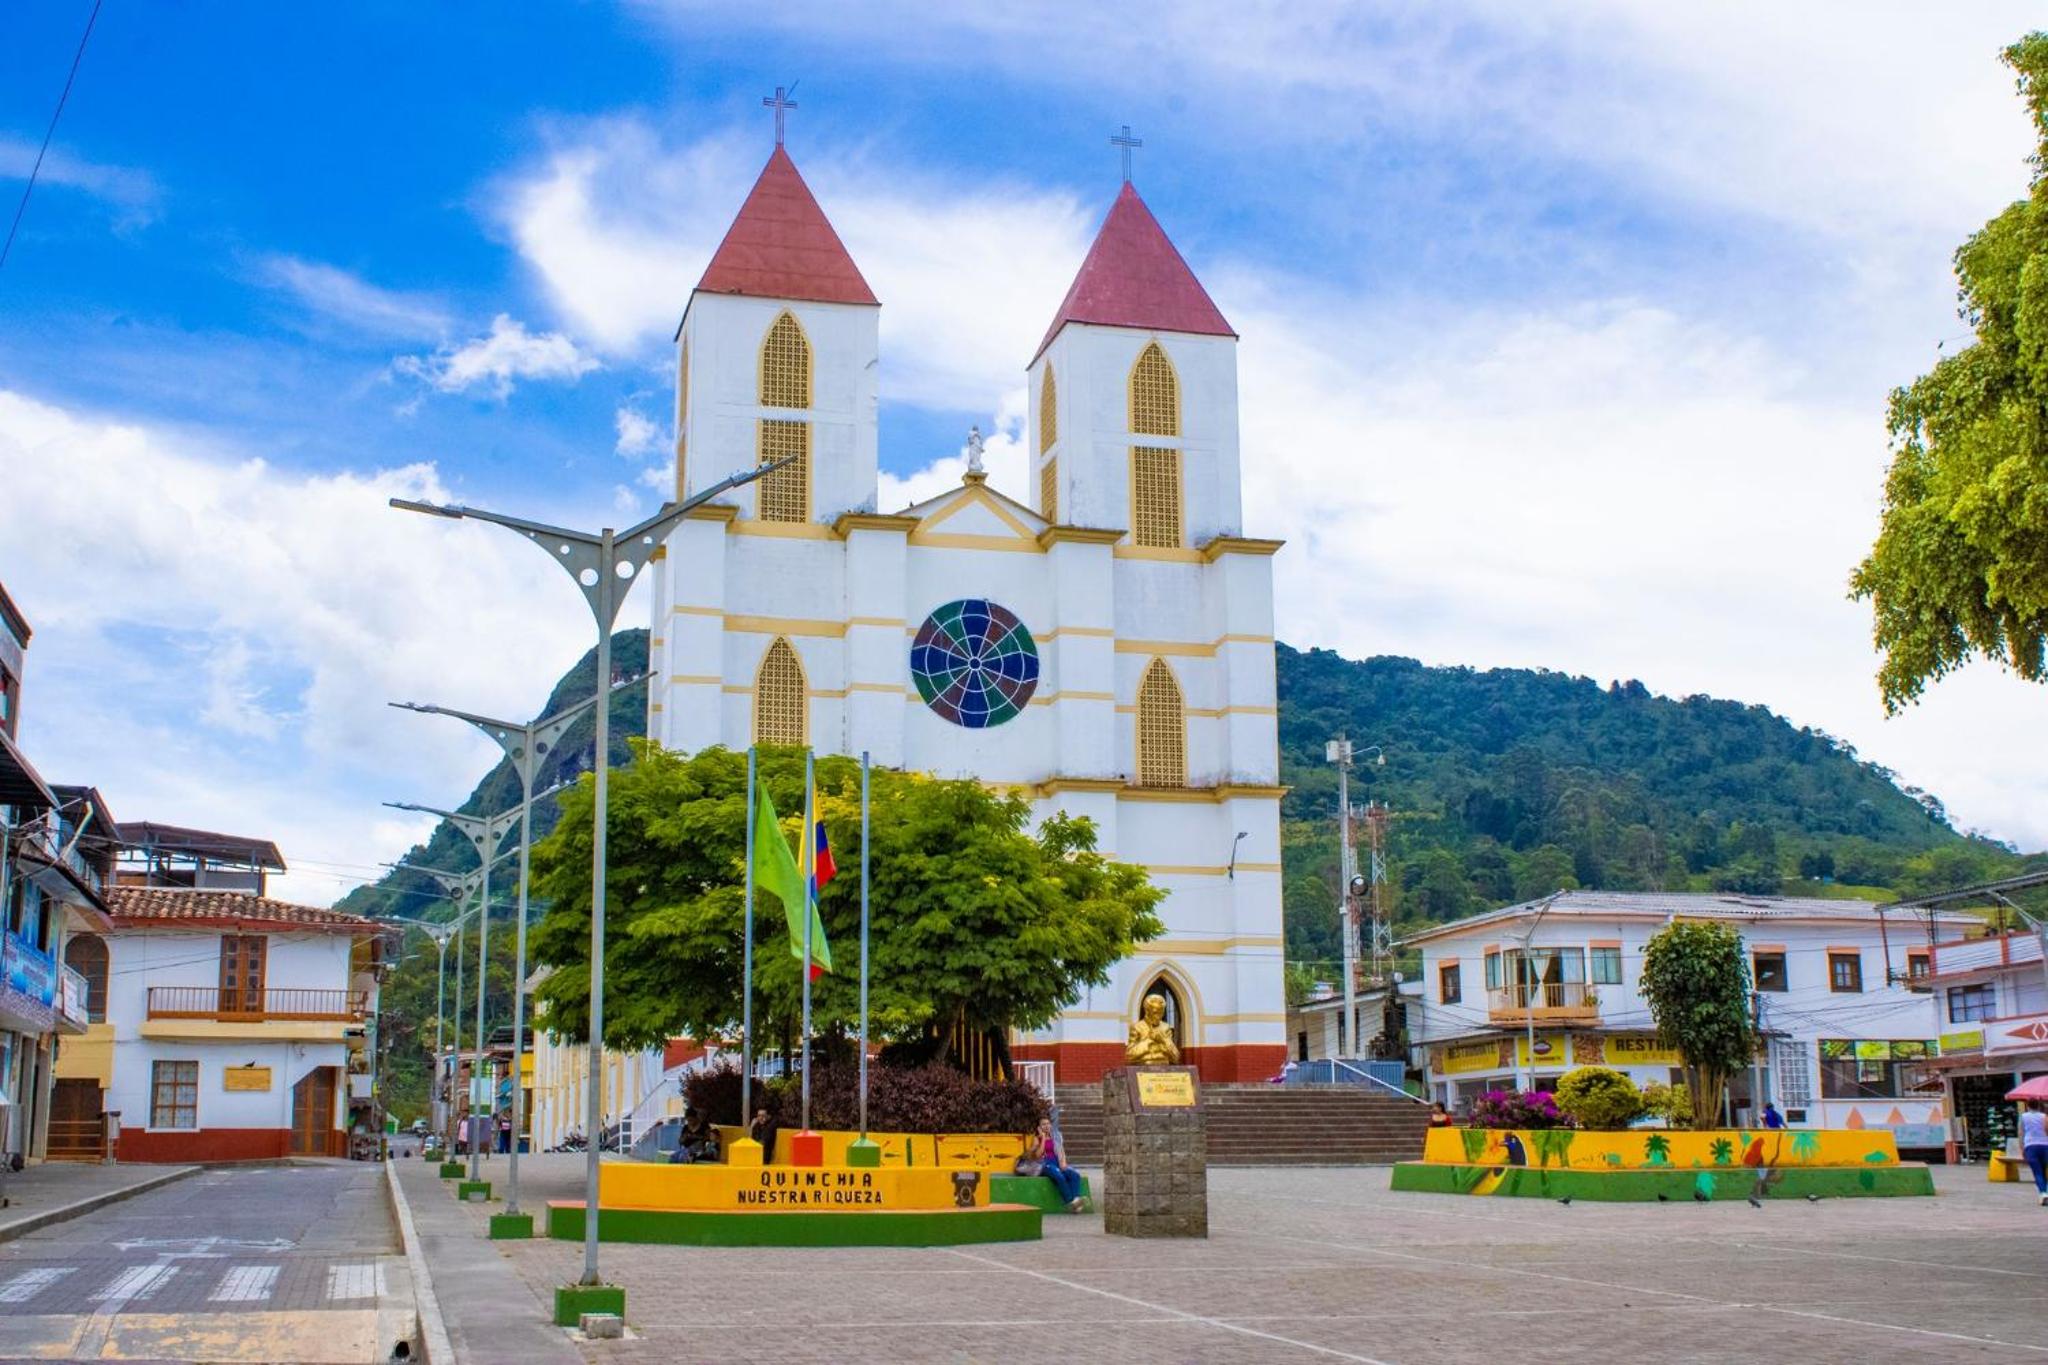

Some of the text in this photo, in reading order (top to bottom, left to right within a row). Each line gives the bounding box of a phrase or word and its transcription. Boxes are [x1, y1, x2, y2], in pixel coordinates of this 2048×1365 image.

[761, 1171, 872, 1188] QUINCHIA
[738, 1190, 883, 1204] NUESTRA RIQUEZA
